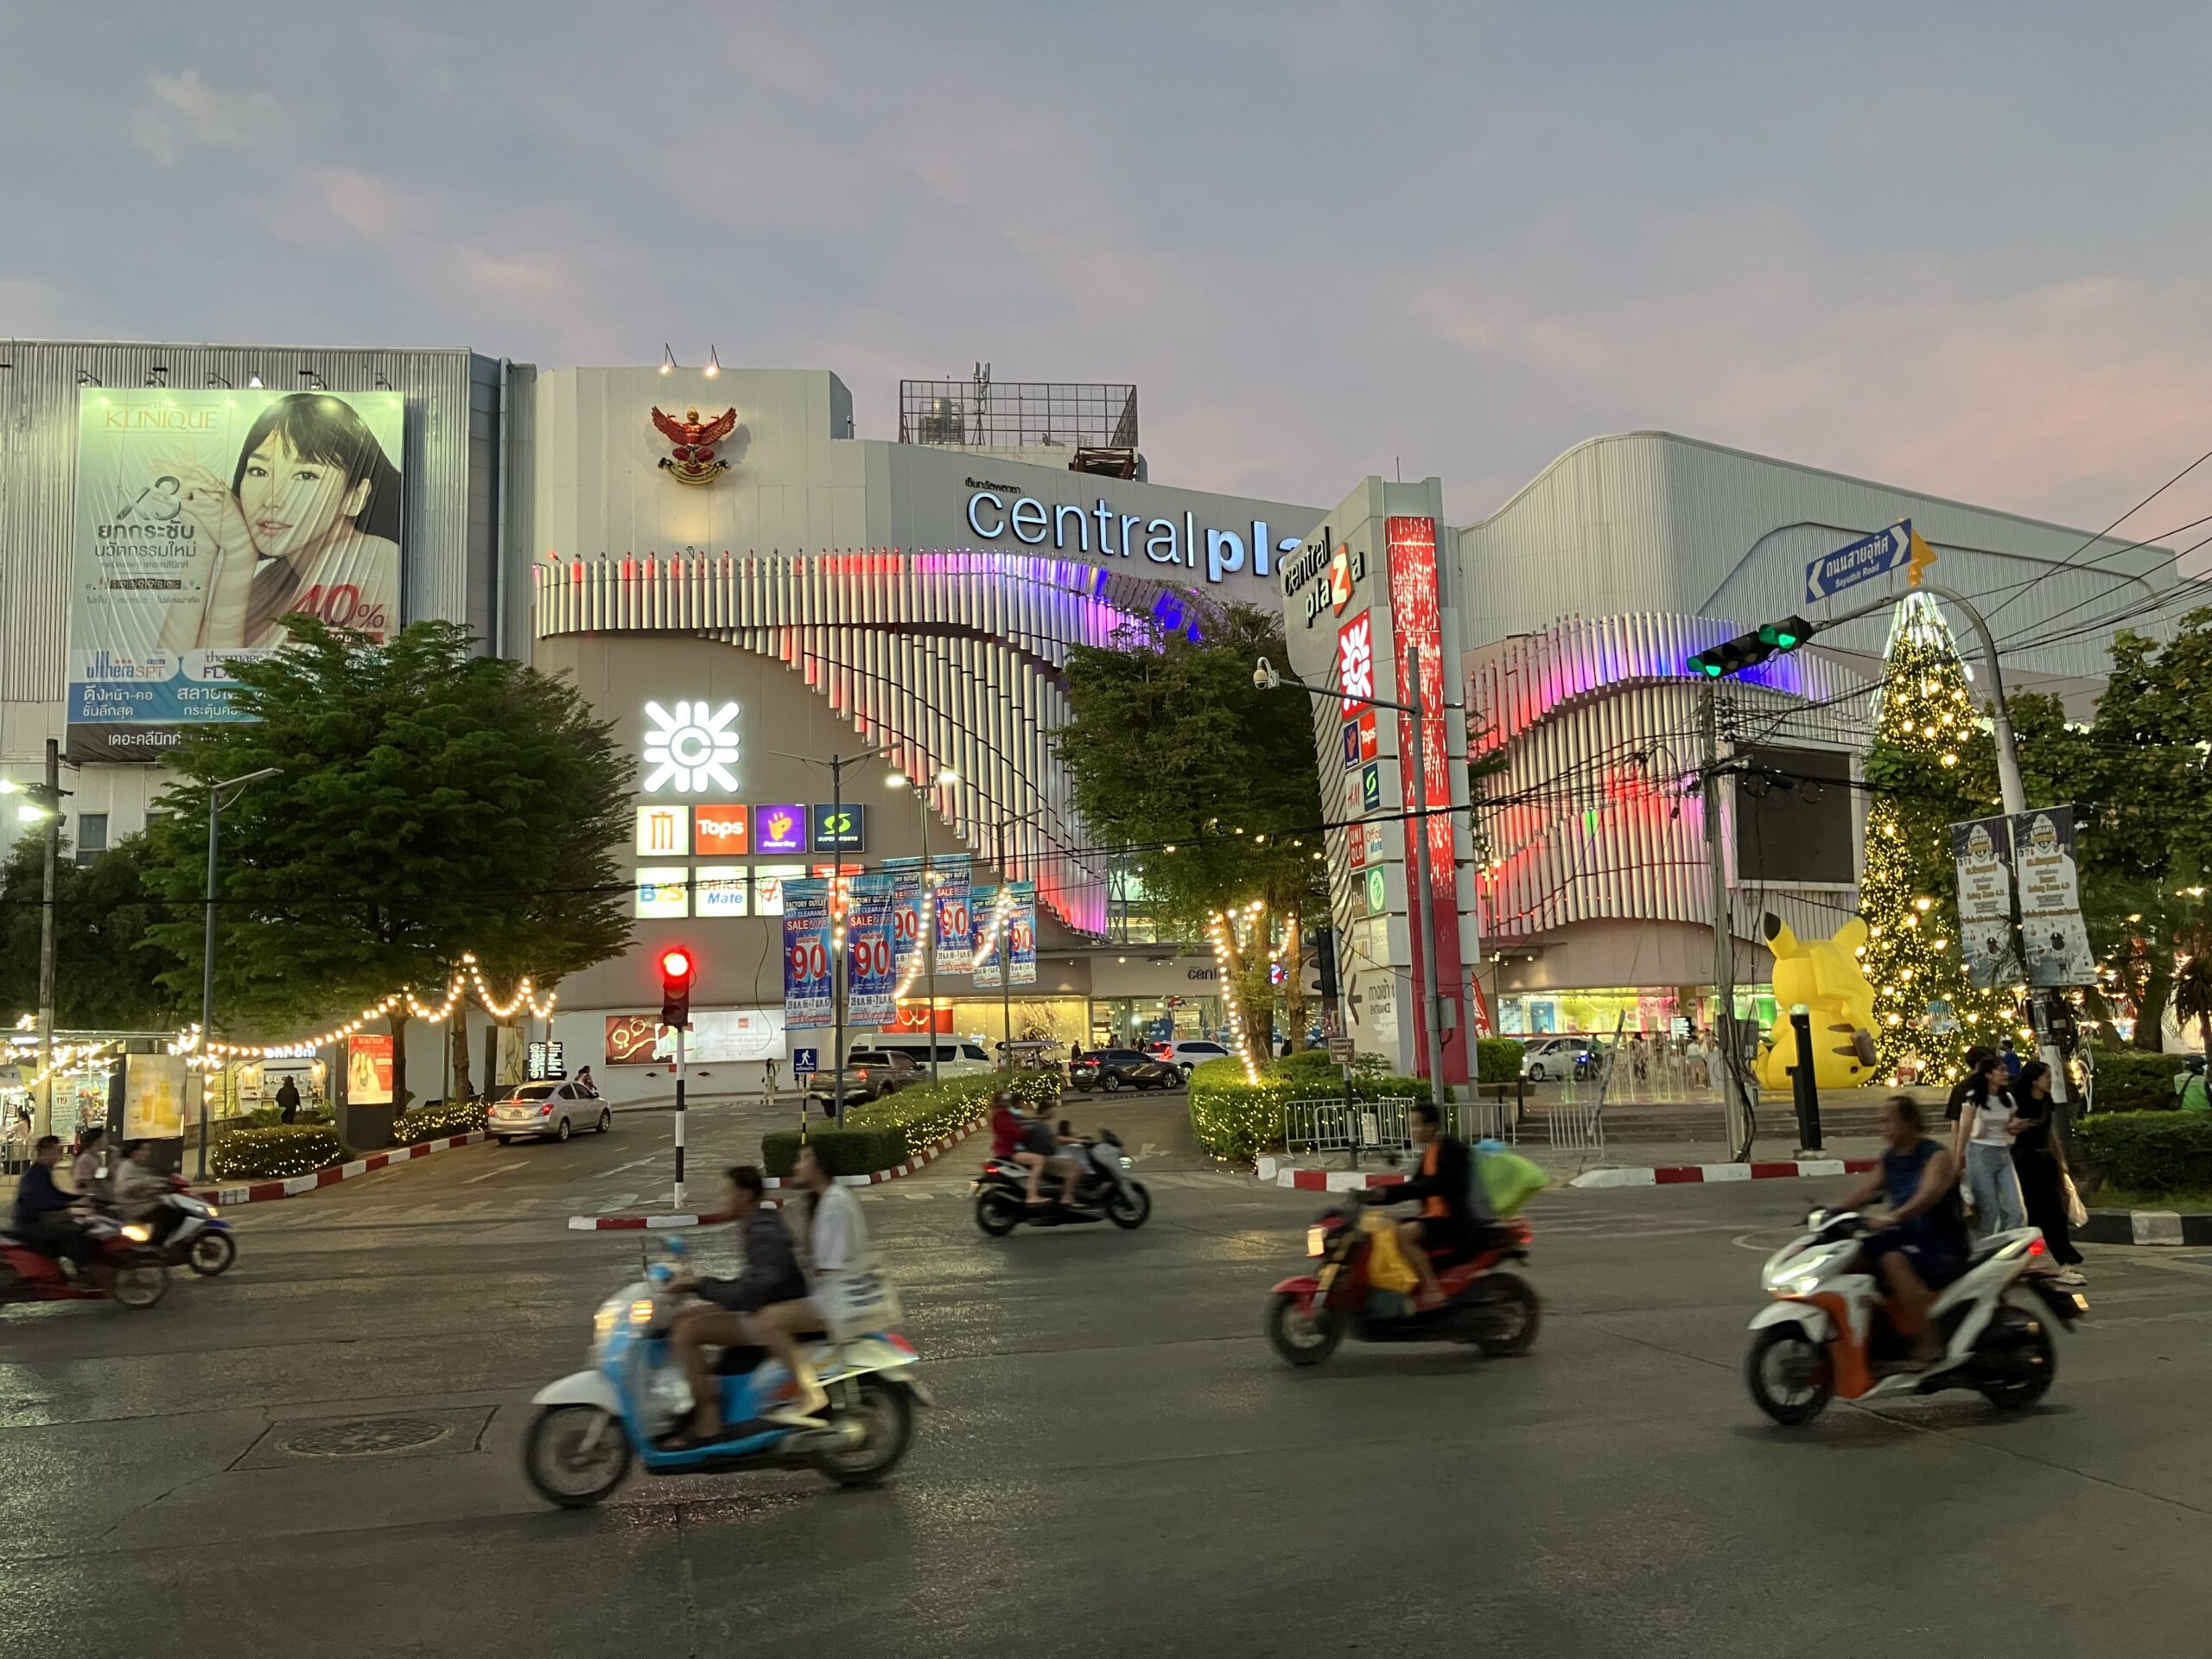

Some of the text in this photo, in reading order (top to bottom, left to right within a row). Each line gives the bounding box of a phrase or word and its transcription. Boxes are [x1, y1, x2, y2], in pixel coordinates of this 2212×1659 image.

[105, 410, 218, 429] KLINIQUE
[98, 519, 195, 539] ยกกระชับ
[967, 491, 1303, 583] central pla
[94, 540, 197, 557] นวัตกรรมใหม่
[1826, 534, 1889, 578] ถนนสายอุทิศ
[1284, 526, 1332, 596] central
[1863, 562, 1880, 576] Road
[82, 701, 134, 719] ชั้นลึกสุด
[1361, 728, 1376, 744] Tops
[697, 819, 745, 839] Tops
[1350, 827, 1362, 843] UNI
[1351, 844, 1363, 863] QLO
[639, 883, 683, 903] B2S
[707, 893, 743, 904] Mate
[936, 887, 954, 896] SALE
[785, 899, 827, 909] FACTORY OUTLET
[787, 919, 809, 931] SALE
[850, 916, 873, 926] SALE
[1370, 1003, 1391, 1015] ENTRANCE
[56, 1096, 68, 1105] 119
